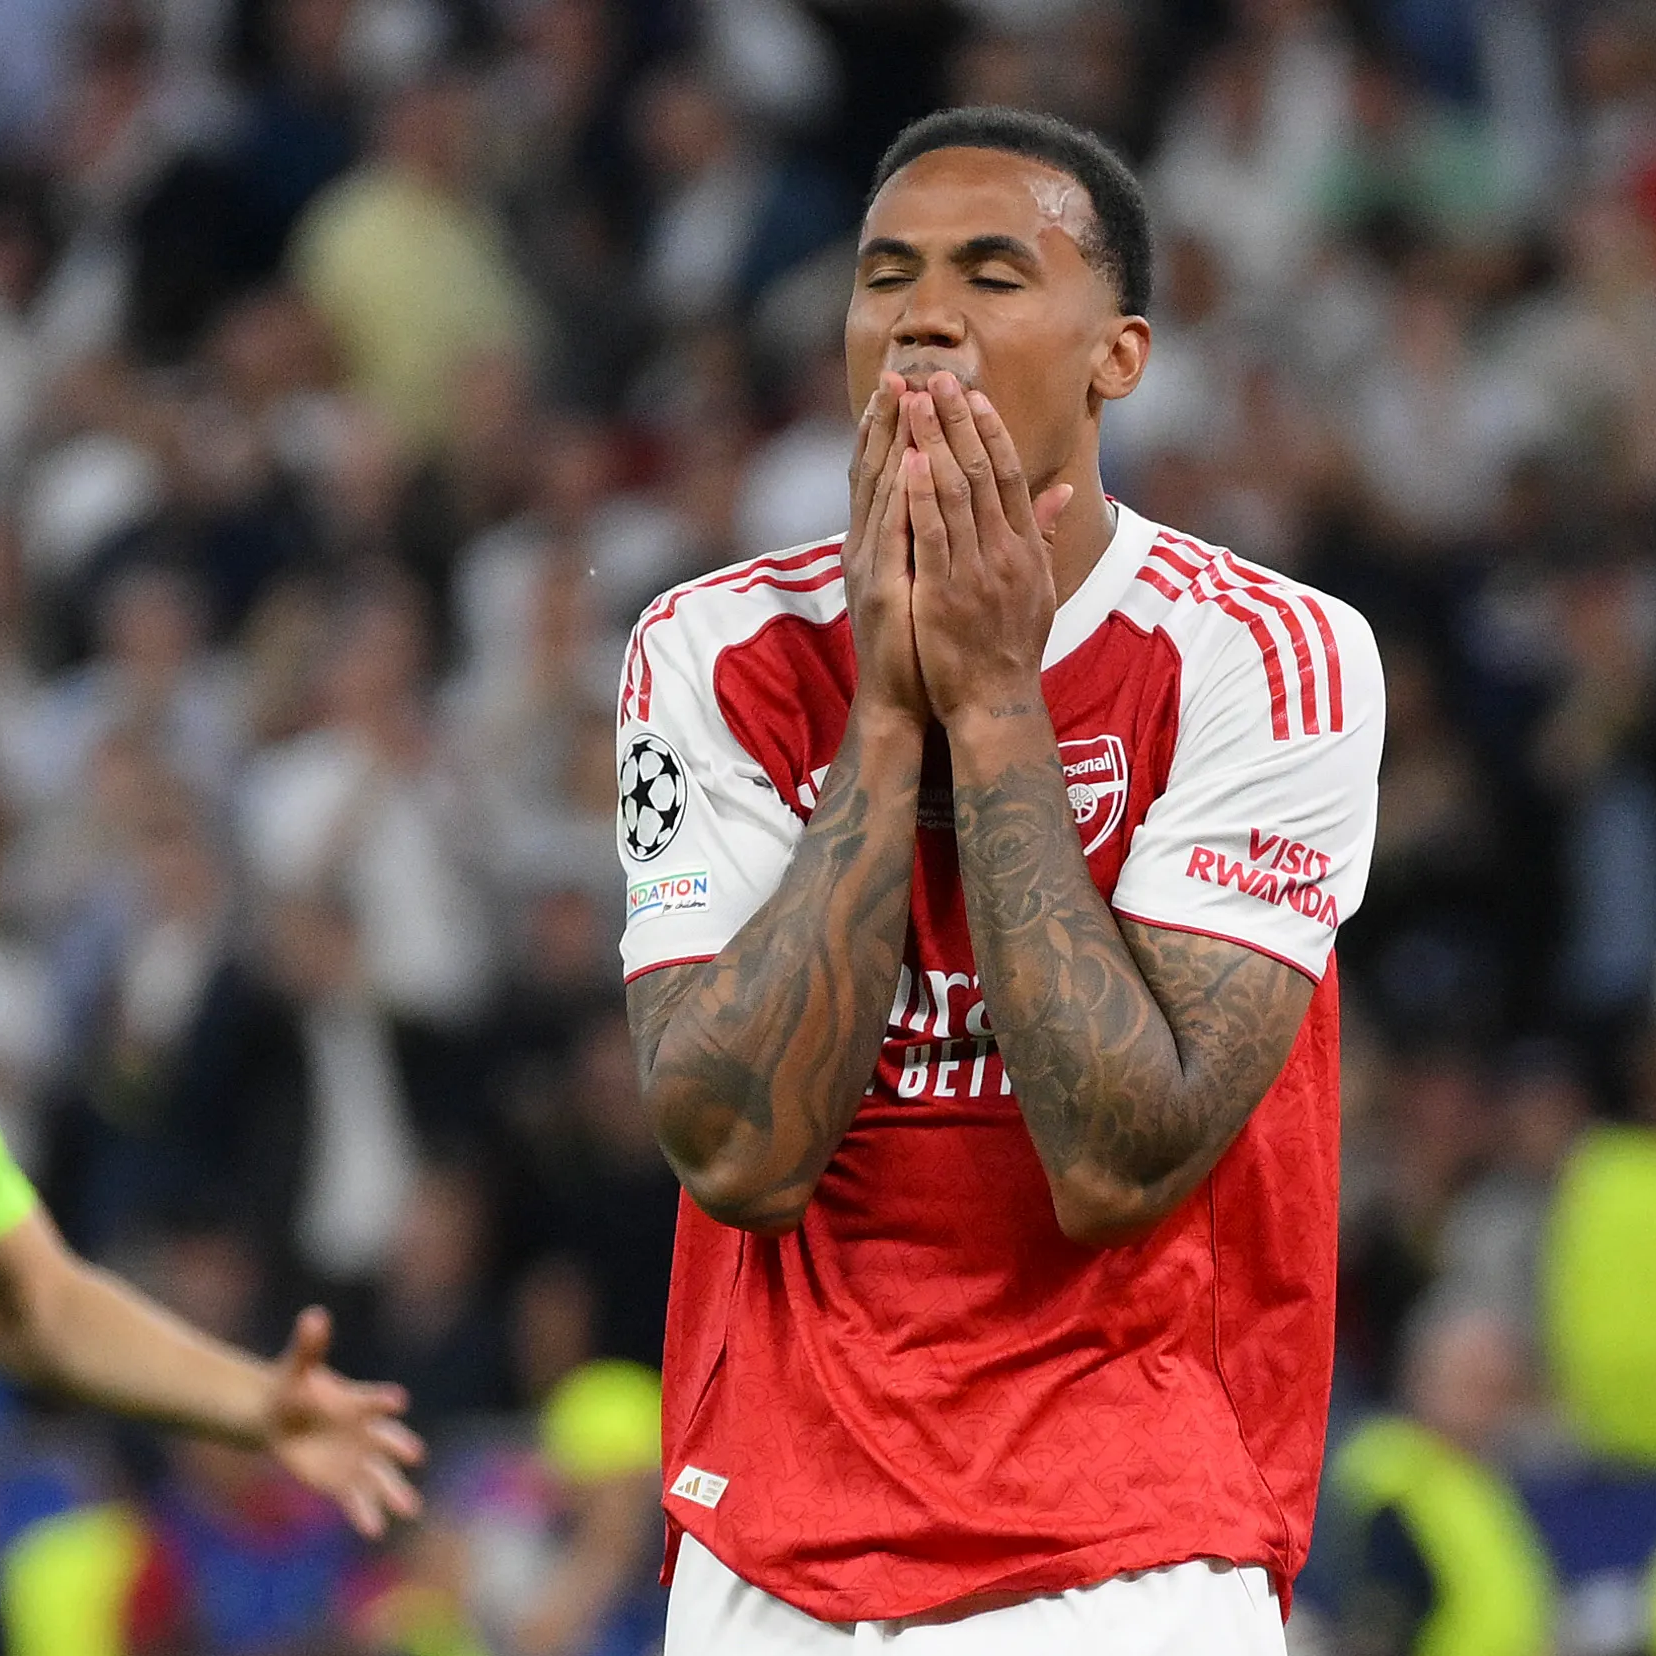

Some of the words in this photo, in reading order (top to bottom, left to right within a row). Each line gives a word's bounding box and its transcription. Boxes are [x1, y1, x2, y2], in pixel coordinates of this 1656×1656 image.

[1062, 751, 1112, 777] rsenal
[1249, 827, 1331, 880] VISIT
[629, 877, 708, 907] NDATION
[1185, 845, 1339, 929] RWANDA
